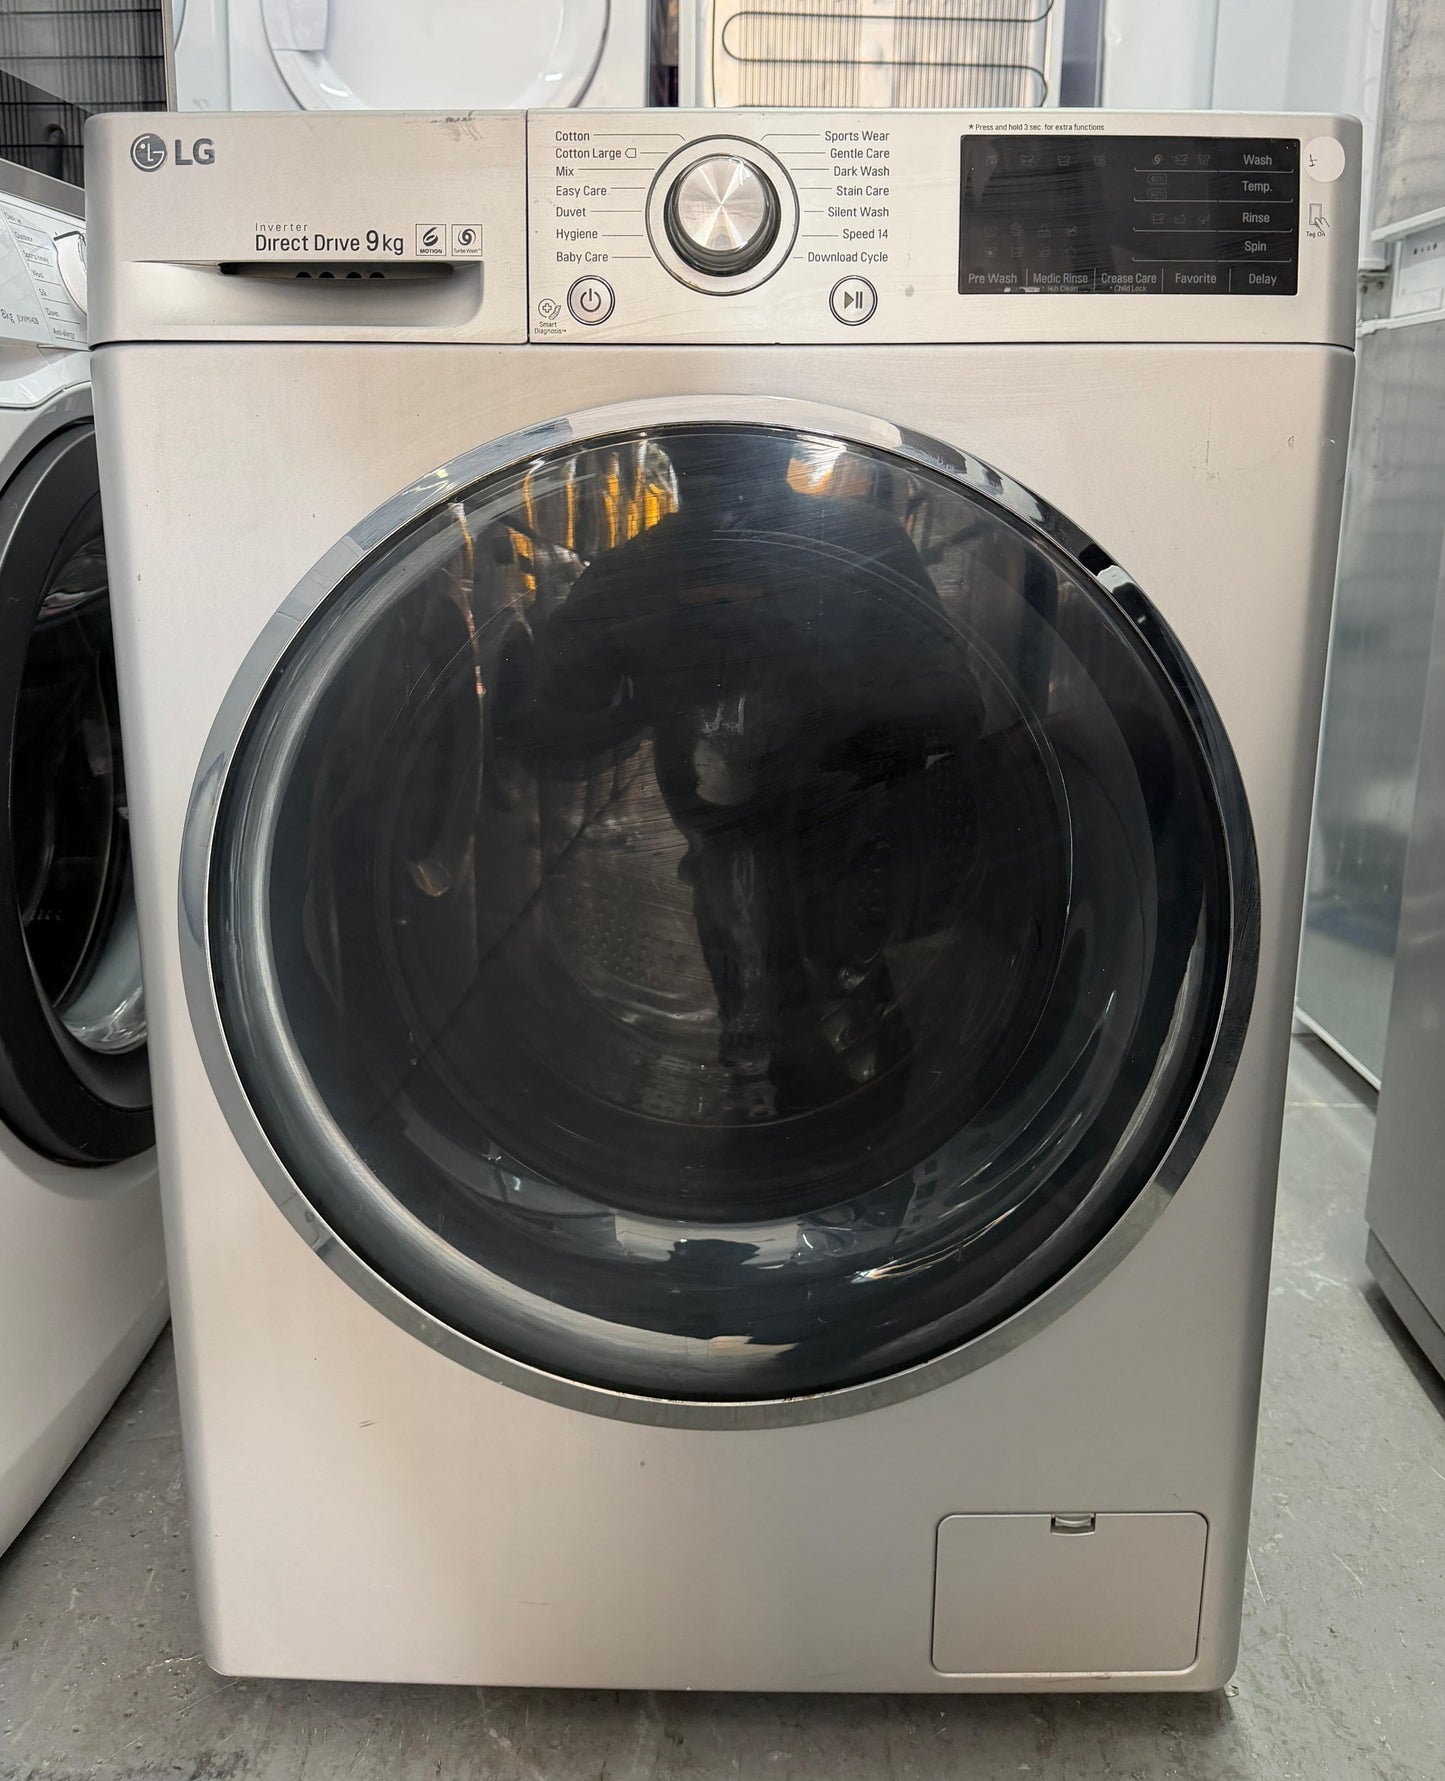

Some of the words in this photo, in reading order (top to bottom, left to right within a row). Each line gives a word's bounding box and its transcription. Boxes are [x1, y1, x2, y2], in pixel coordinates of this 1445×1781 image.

[975, 123, 994, 131] Press
[995, 123, 1007, 131] and
[1008, 123, 1023, 131] hold
[1024, 123, 1028, 131] 3
[1044, 123, 1054, 131] for
[1074, 123, 1105, 131] functions
[555, 130, 590, 142] Cotton
[824, 130, 860, 142] Sports
[862, 130, 890, 141] Wear
[175, 138, 215, 166] LG
[555, 147, 590, 159] Cotton
[592, 147, 622, 161] Large
[830, 148, 863, 158] Gentle
[865, 148, 890, 158] Care
[1243, 154, 1272, 166] Wash
[555, 166, 574, 177] Mix
[833, 165, 857, 177] Dark
[860, 165, 890, 177] Wash
[556, 185, 581, 199] Easy
[583, 185, 607, 196] Care
[836, 185, 863, 197] Stain
[865, 185, 890, 197] Care
[1242, 180, 1272, 194] Temp.
[556, 206, 587, 218] Duvet
[828, 206, 857, 218] Silent
[859, 206, 890, 218] Wash
[1242, 212, 1270, 223] Rinse
[255, 222, 308, 232] Inverter
[556, 228, 598, 242] Hygiene
[842, 228, 876, 242] Speed
[878, 228, 889, 240] 14
[256, 234, 308, 251] Direct
[314, 234, 360, 251] Drive
[366, 230, 404, 254] 9kg
[1244, 240, 1266, 253] Spin
[556, 251, 582, 265] Baby
[584, 251, 608, 263] Care
[808, 250, 859, 263] Download
[860, 251, 888, 265] Cycle
[968, 273, 985, 284] Pre
[988, 273, 1017, 284] Wash
[1033, 272, 1060, 284] Medic
[1063, 272, 1088, 284] Rinse
[1101, 273, 1132, 284] Crease
[1136, 273, 1156, 284] Care
[1175, 273, 1216, 284] Favorite
[1248, 274, 1277, 286] Delay
